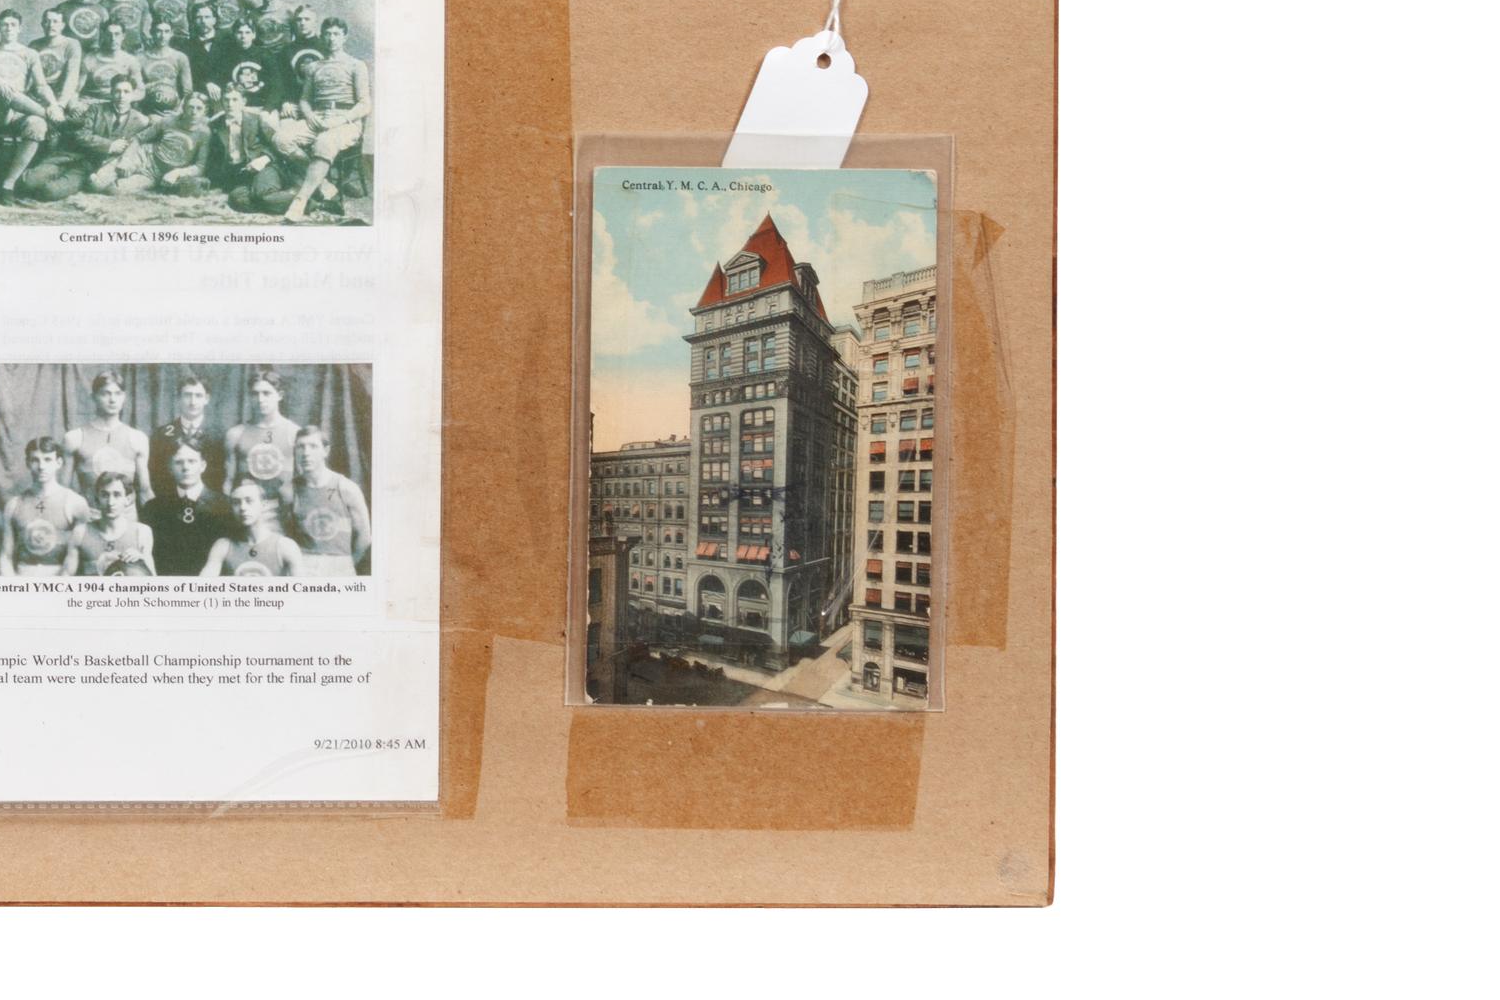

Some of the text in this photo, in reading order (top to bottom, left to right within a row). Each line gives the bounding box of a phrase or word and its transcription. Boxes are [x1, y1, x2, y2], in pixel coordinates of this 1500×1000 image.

[666, 180, 678, 191] Y.
[680, 180, 694, 191] M.
[697, 180, 708, 191] C.
[729, 181, 773, 193] Chicago
[59, 232, 285, 245] Central YMCA 1896 league champions
[32, 582, 74, 593] YMCA
[78, 582, 105, 592] 1904
[108, 582, 170, 595] champions
[173, 582, 187, 592] of
[189, 582, 226, 593] United
[228, 582, 264, 593] States
[267, 583, 289, 593] and
[292, 582, 341, 593] Canada,
[344, 582, 366, 592] with
[67, 597, 284, 610] the great John Schommer (1) in the lineup
[32, 654, 80, 666] World's
[84, 654, 149, 666] Basketball
[153, 654, 242, 669] Championship
[246, 656, 314, 666] tournament
[318, 656, 330, 666] to
[334, 654, 352, 666] the
[314, 739, 426, 750] 9/21/2010 8:45 AM
